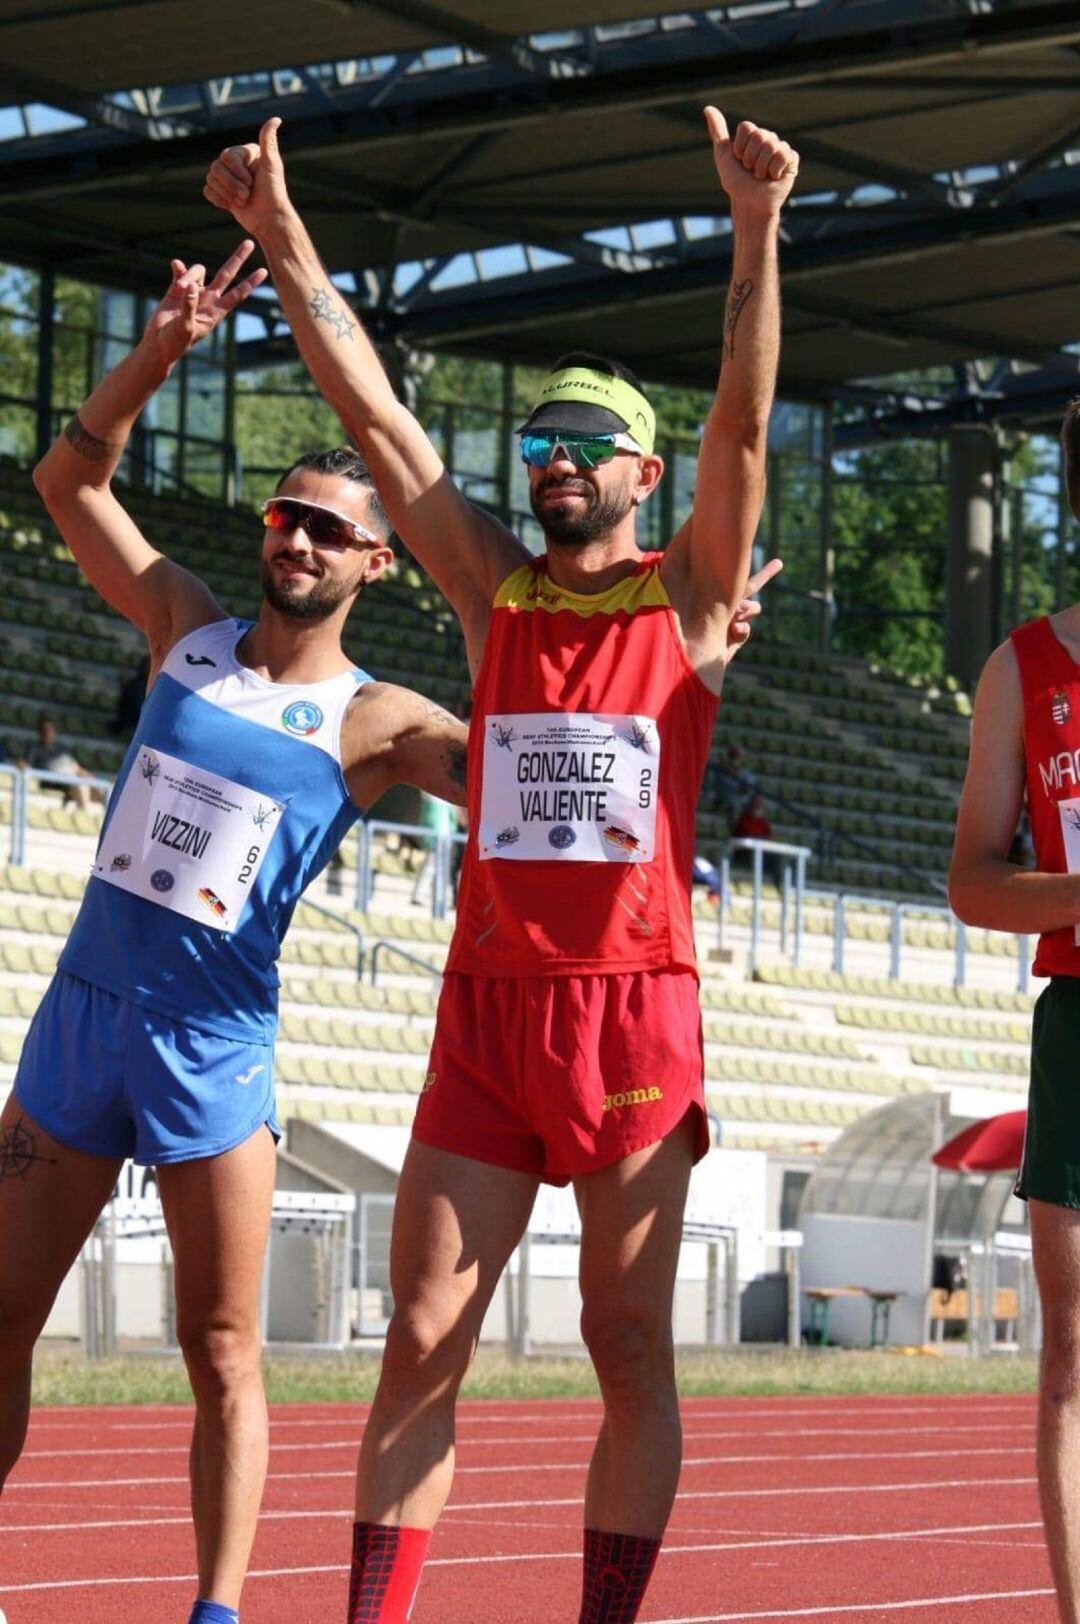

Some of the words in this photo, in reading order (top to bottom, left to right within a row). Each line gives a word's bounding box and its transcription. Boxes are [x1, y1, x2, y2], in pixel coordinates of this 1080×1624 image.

[517, 751, 616, 784] GONZALEZ
[520, 790, 607, 822] VALIENTE
[151, 810, 212, 860] VIZZINI
